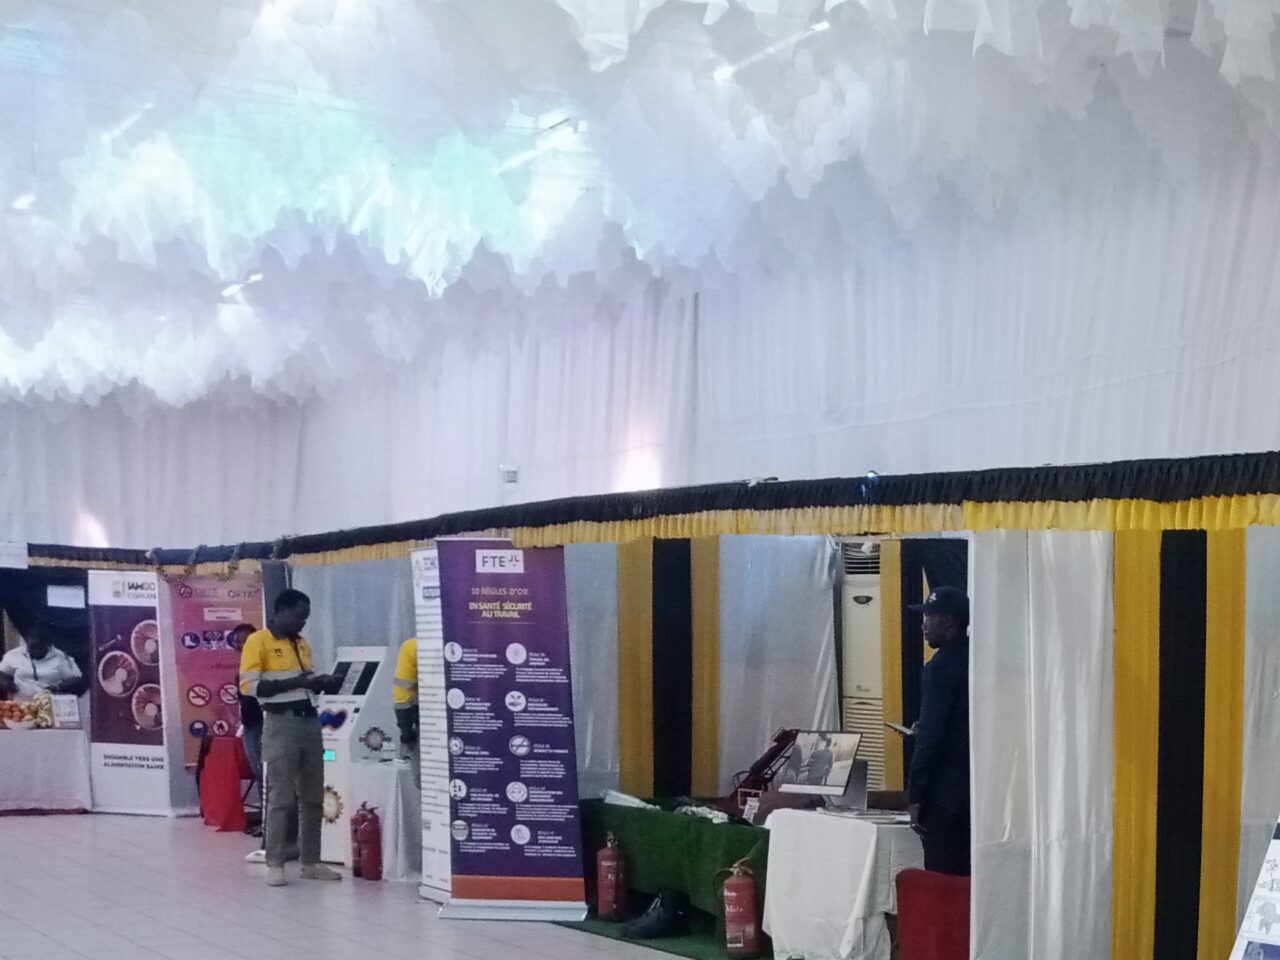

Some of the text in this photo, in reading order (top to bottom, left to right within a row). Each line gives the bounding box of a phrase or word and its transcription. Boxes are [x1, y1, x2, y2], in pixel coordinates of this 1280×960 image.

[481, 555, 506, 568] FTE
[468, 600, 532, 611] EN SANTÉ SÉCURITÉ
[481, 610, 520, 618] AU TRAVAIL
